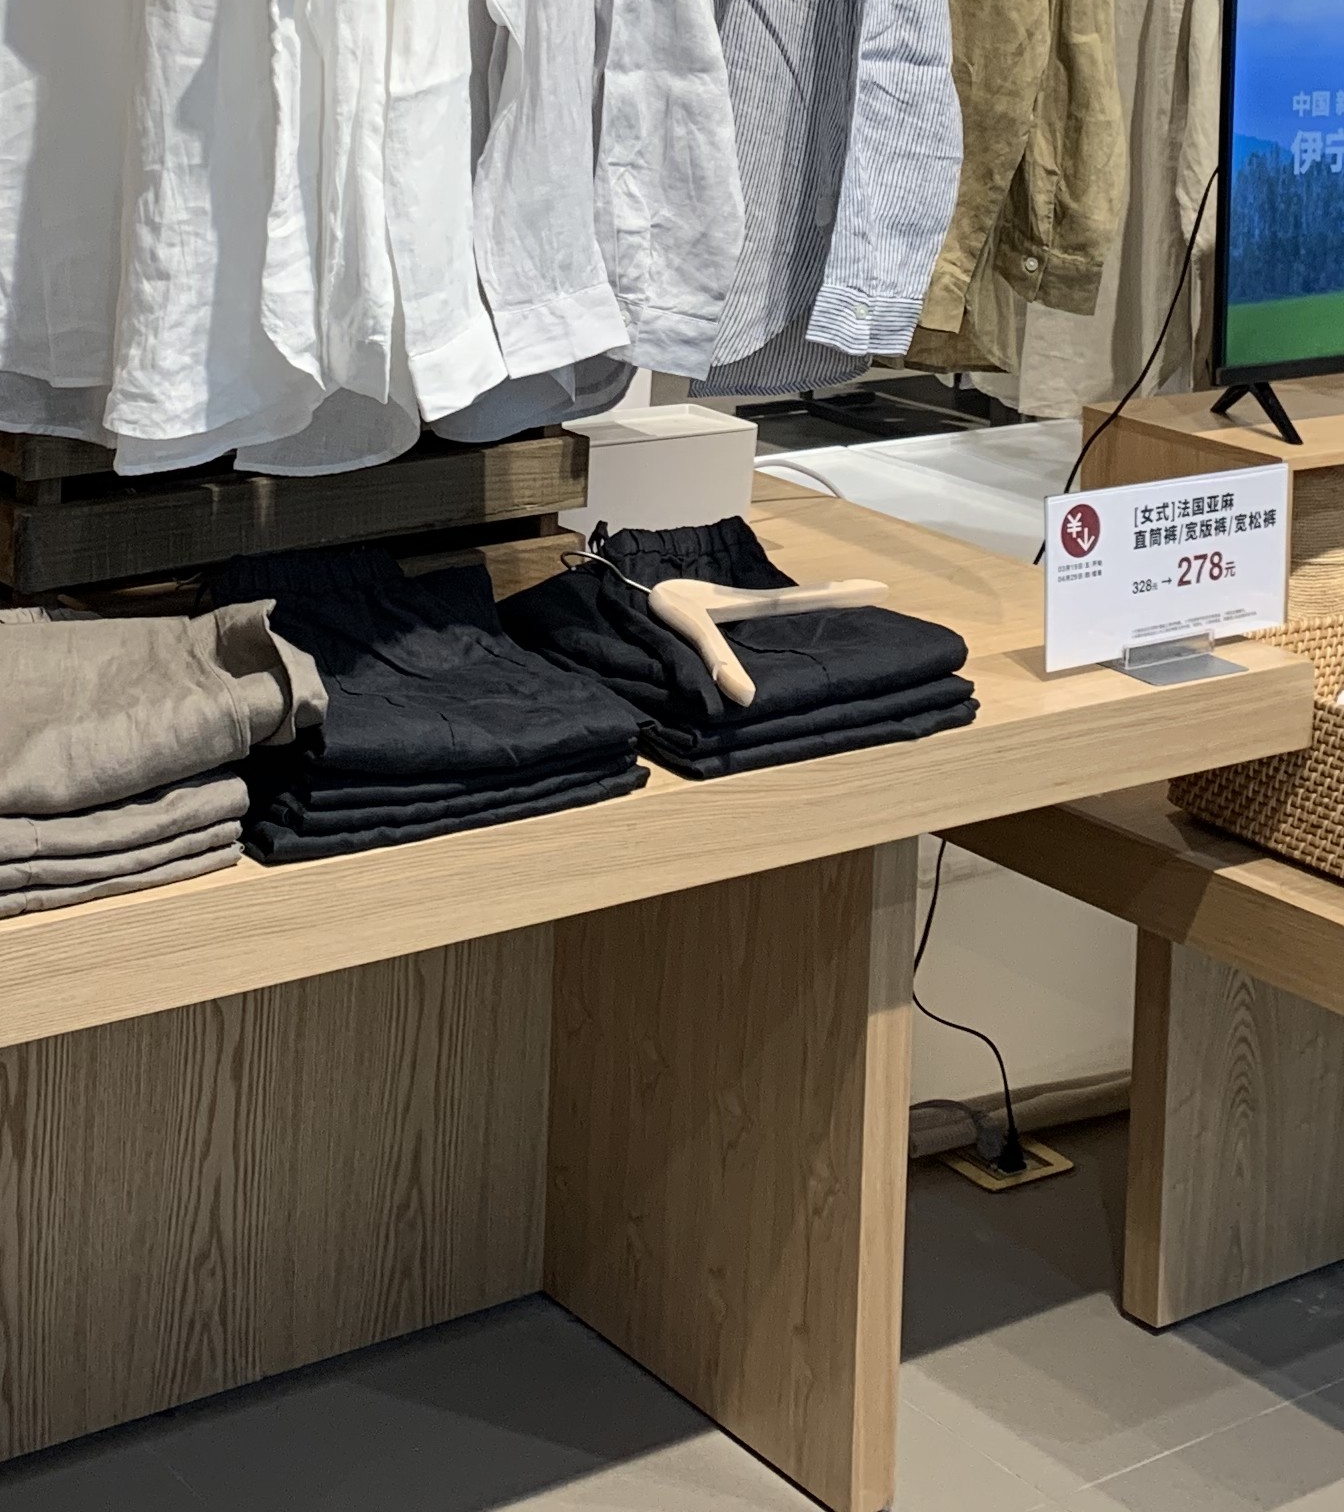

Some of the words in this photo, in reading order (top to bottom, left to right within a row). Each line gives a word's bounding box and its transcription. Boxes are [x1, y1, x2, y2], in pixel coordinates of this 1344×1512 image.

[1292, 90, 1331, 117] 中国
[1133, 492, 1235, 528] [女式]法国亚麻
[1133, 508, 1278, 550] 直筒裤/宽版裤/宽松裤
[1177, 551, 1236, 587] 278元
